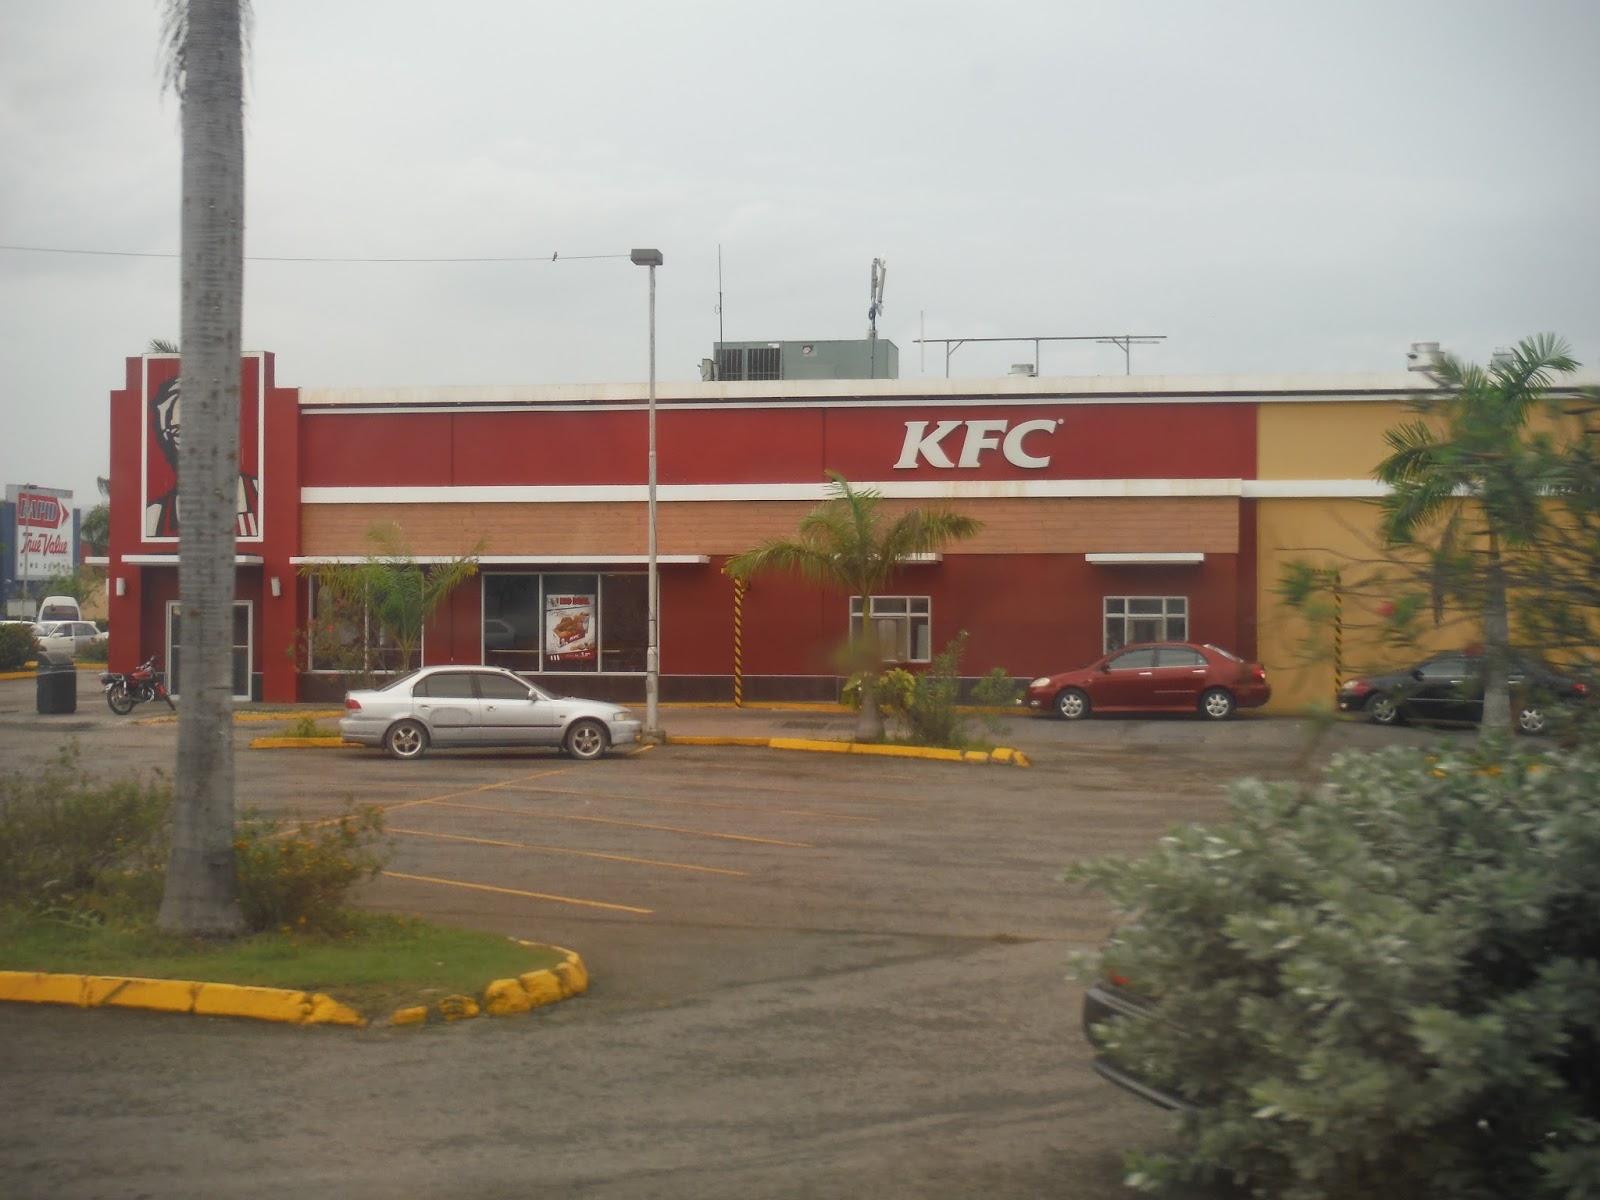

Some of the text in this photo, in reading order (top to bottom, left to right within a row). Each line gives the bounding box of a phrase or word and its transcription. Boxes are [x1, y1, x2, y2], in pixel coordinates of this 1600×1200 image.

[892, 419, 1057, 469] KFC
[20, 532, 67, 556] True Value
